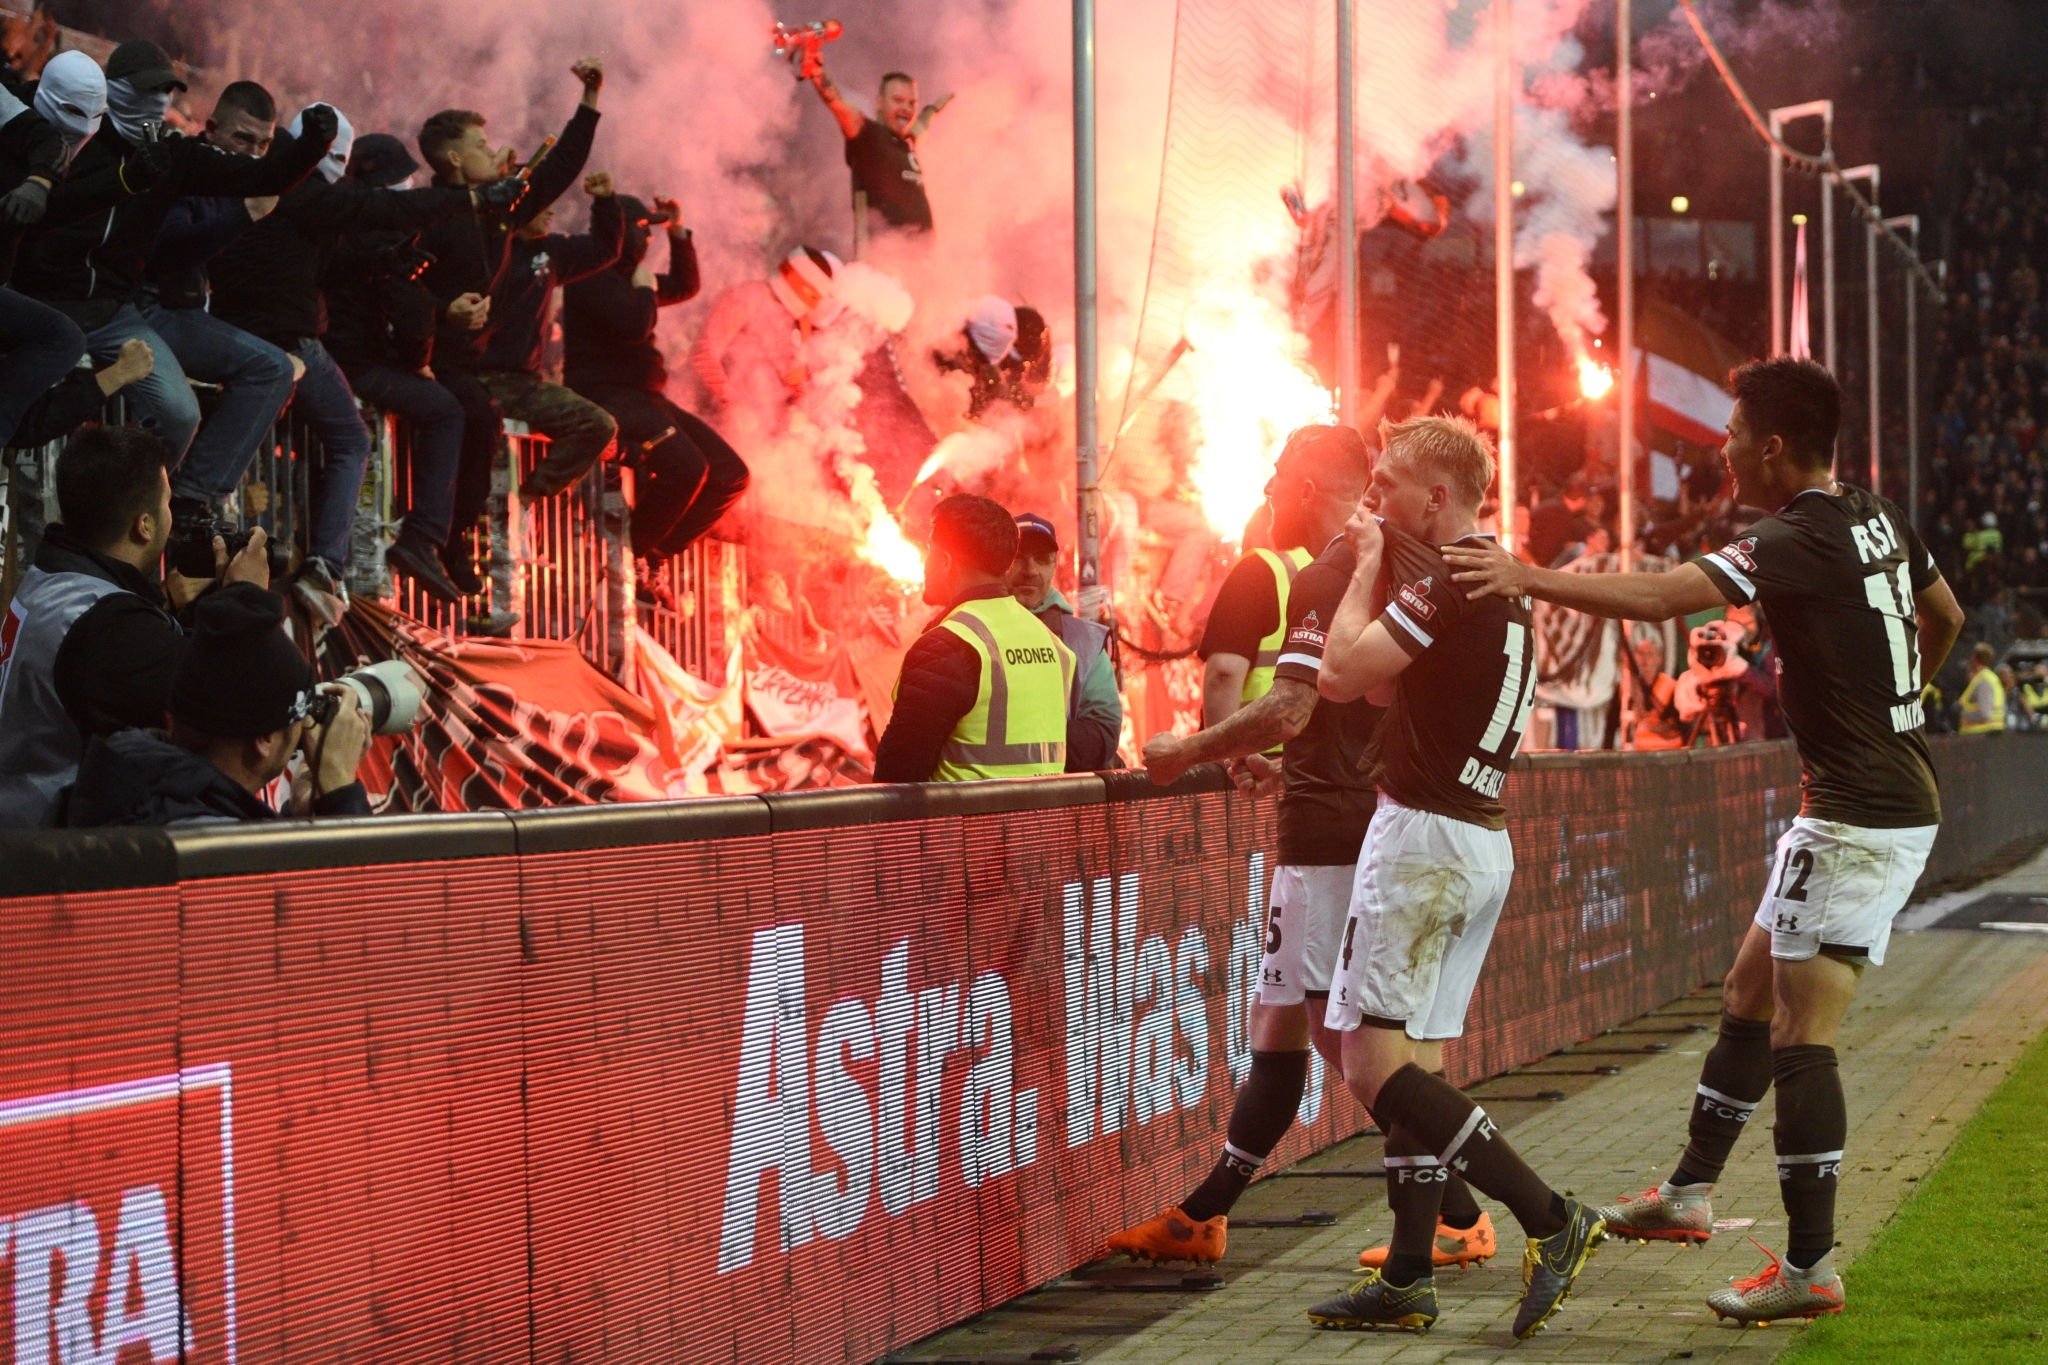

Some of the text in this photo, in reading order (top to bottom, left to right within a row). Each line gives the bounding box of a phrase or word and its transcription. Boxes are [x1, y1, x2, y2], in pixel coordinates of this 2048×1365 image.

[1400, 590, 1429, 615] ASTRA
[1292, 631, 1324, 645] ASTRA
[1005, 647, 1057, 665] ORDNER
[1774, 847, 1814, 902] 12
[717, 922, 1038, 1276] Astra.
[1063, 872, 1208, 1148] Was
[1702, 1099, 1750, 1122] FCS
[1398, 1167, 1449, 1184] FCS
[0, 1183, 196, 1365] RA
